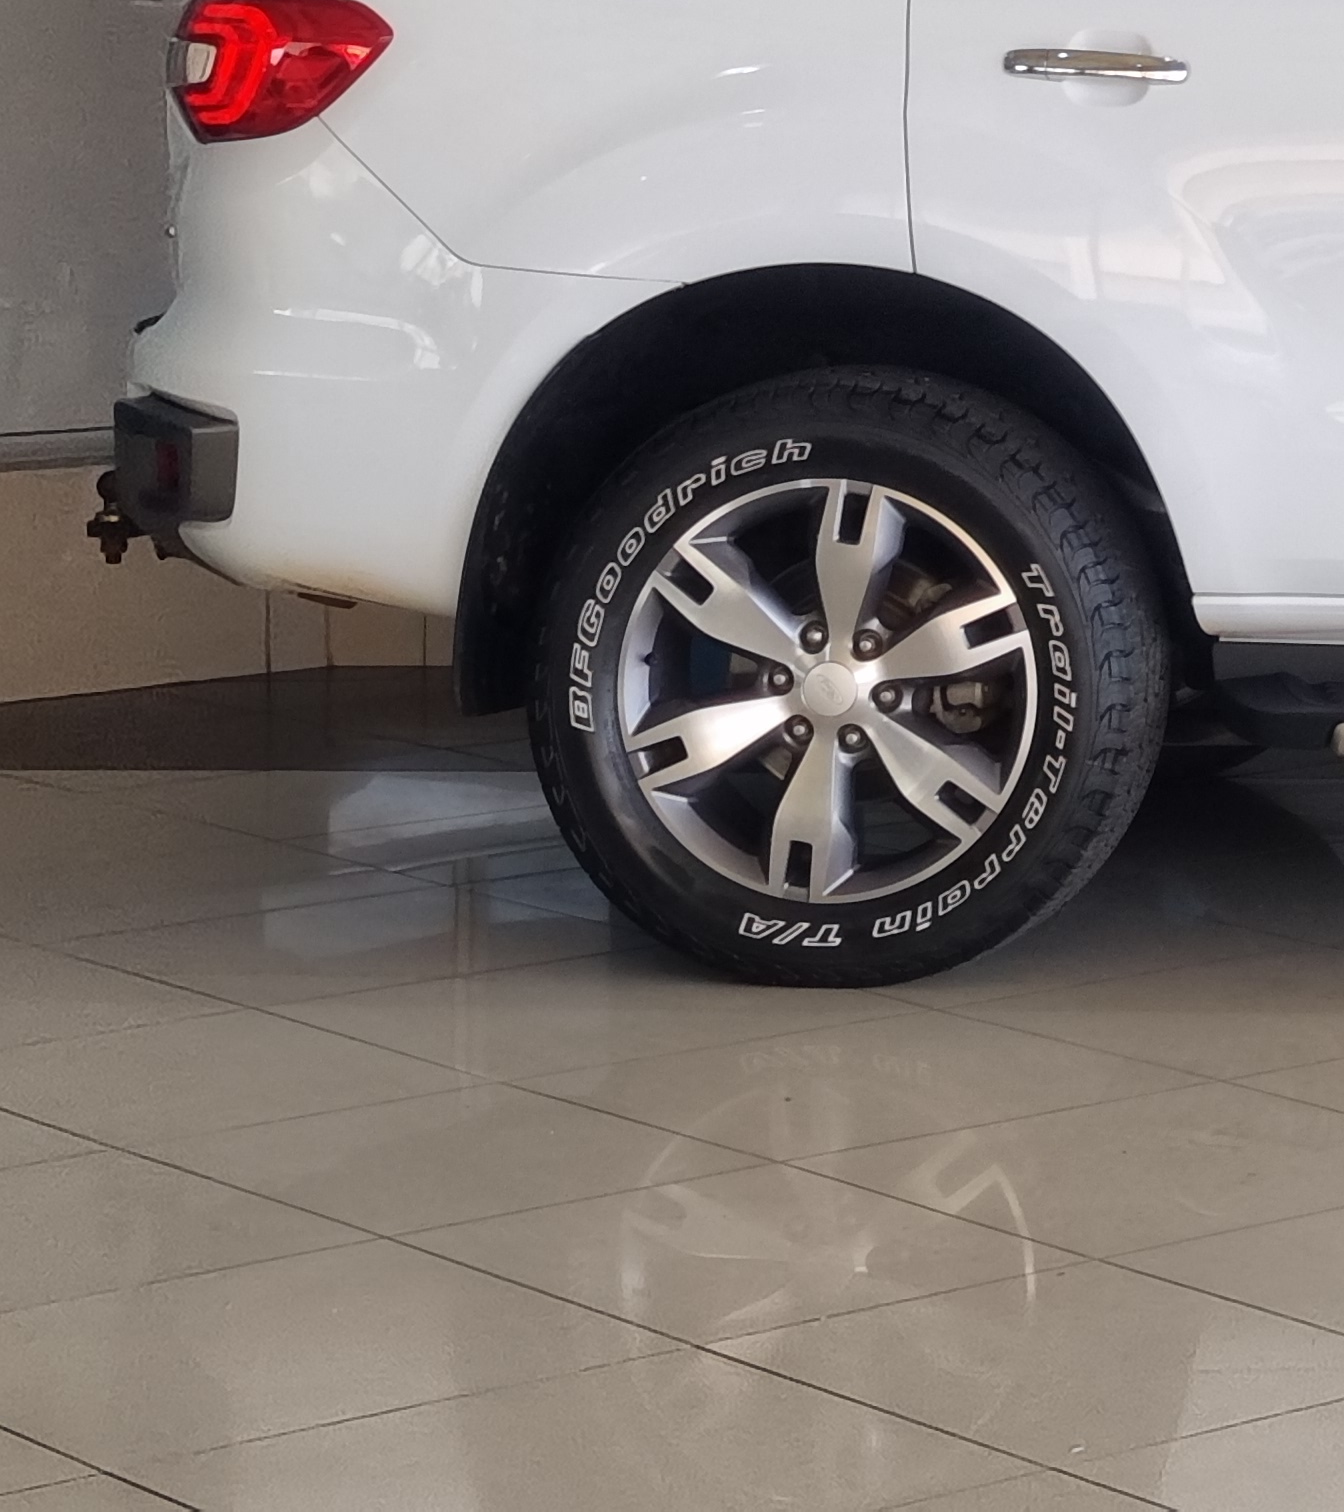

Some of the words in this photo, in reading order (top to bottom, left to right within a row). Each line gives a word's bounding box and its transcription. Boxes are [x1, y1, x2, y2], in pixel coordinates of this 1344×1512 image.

[569, 439, 813, 732] BFGoodrich
[871, 564, 1080, 940] Trail-Terrain
[738, 911, 843, 948] T/A
